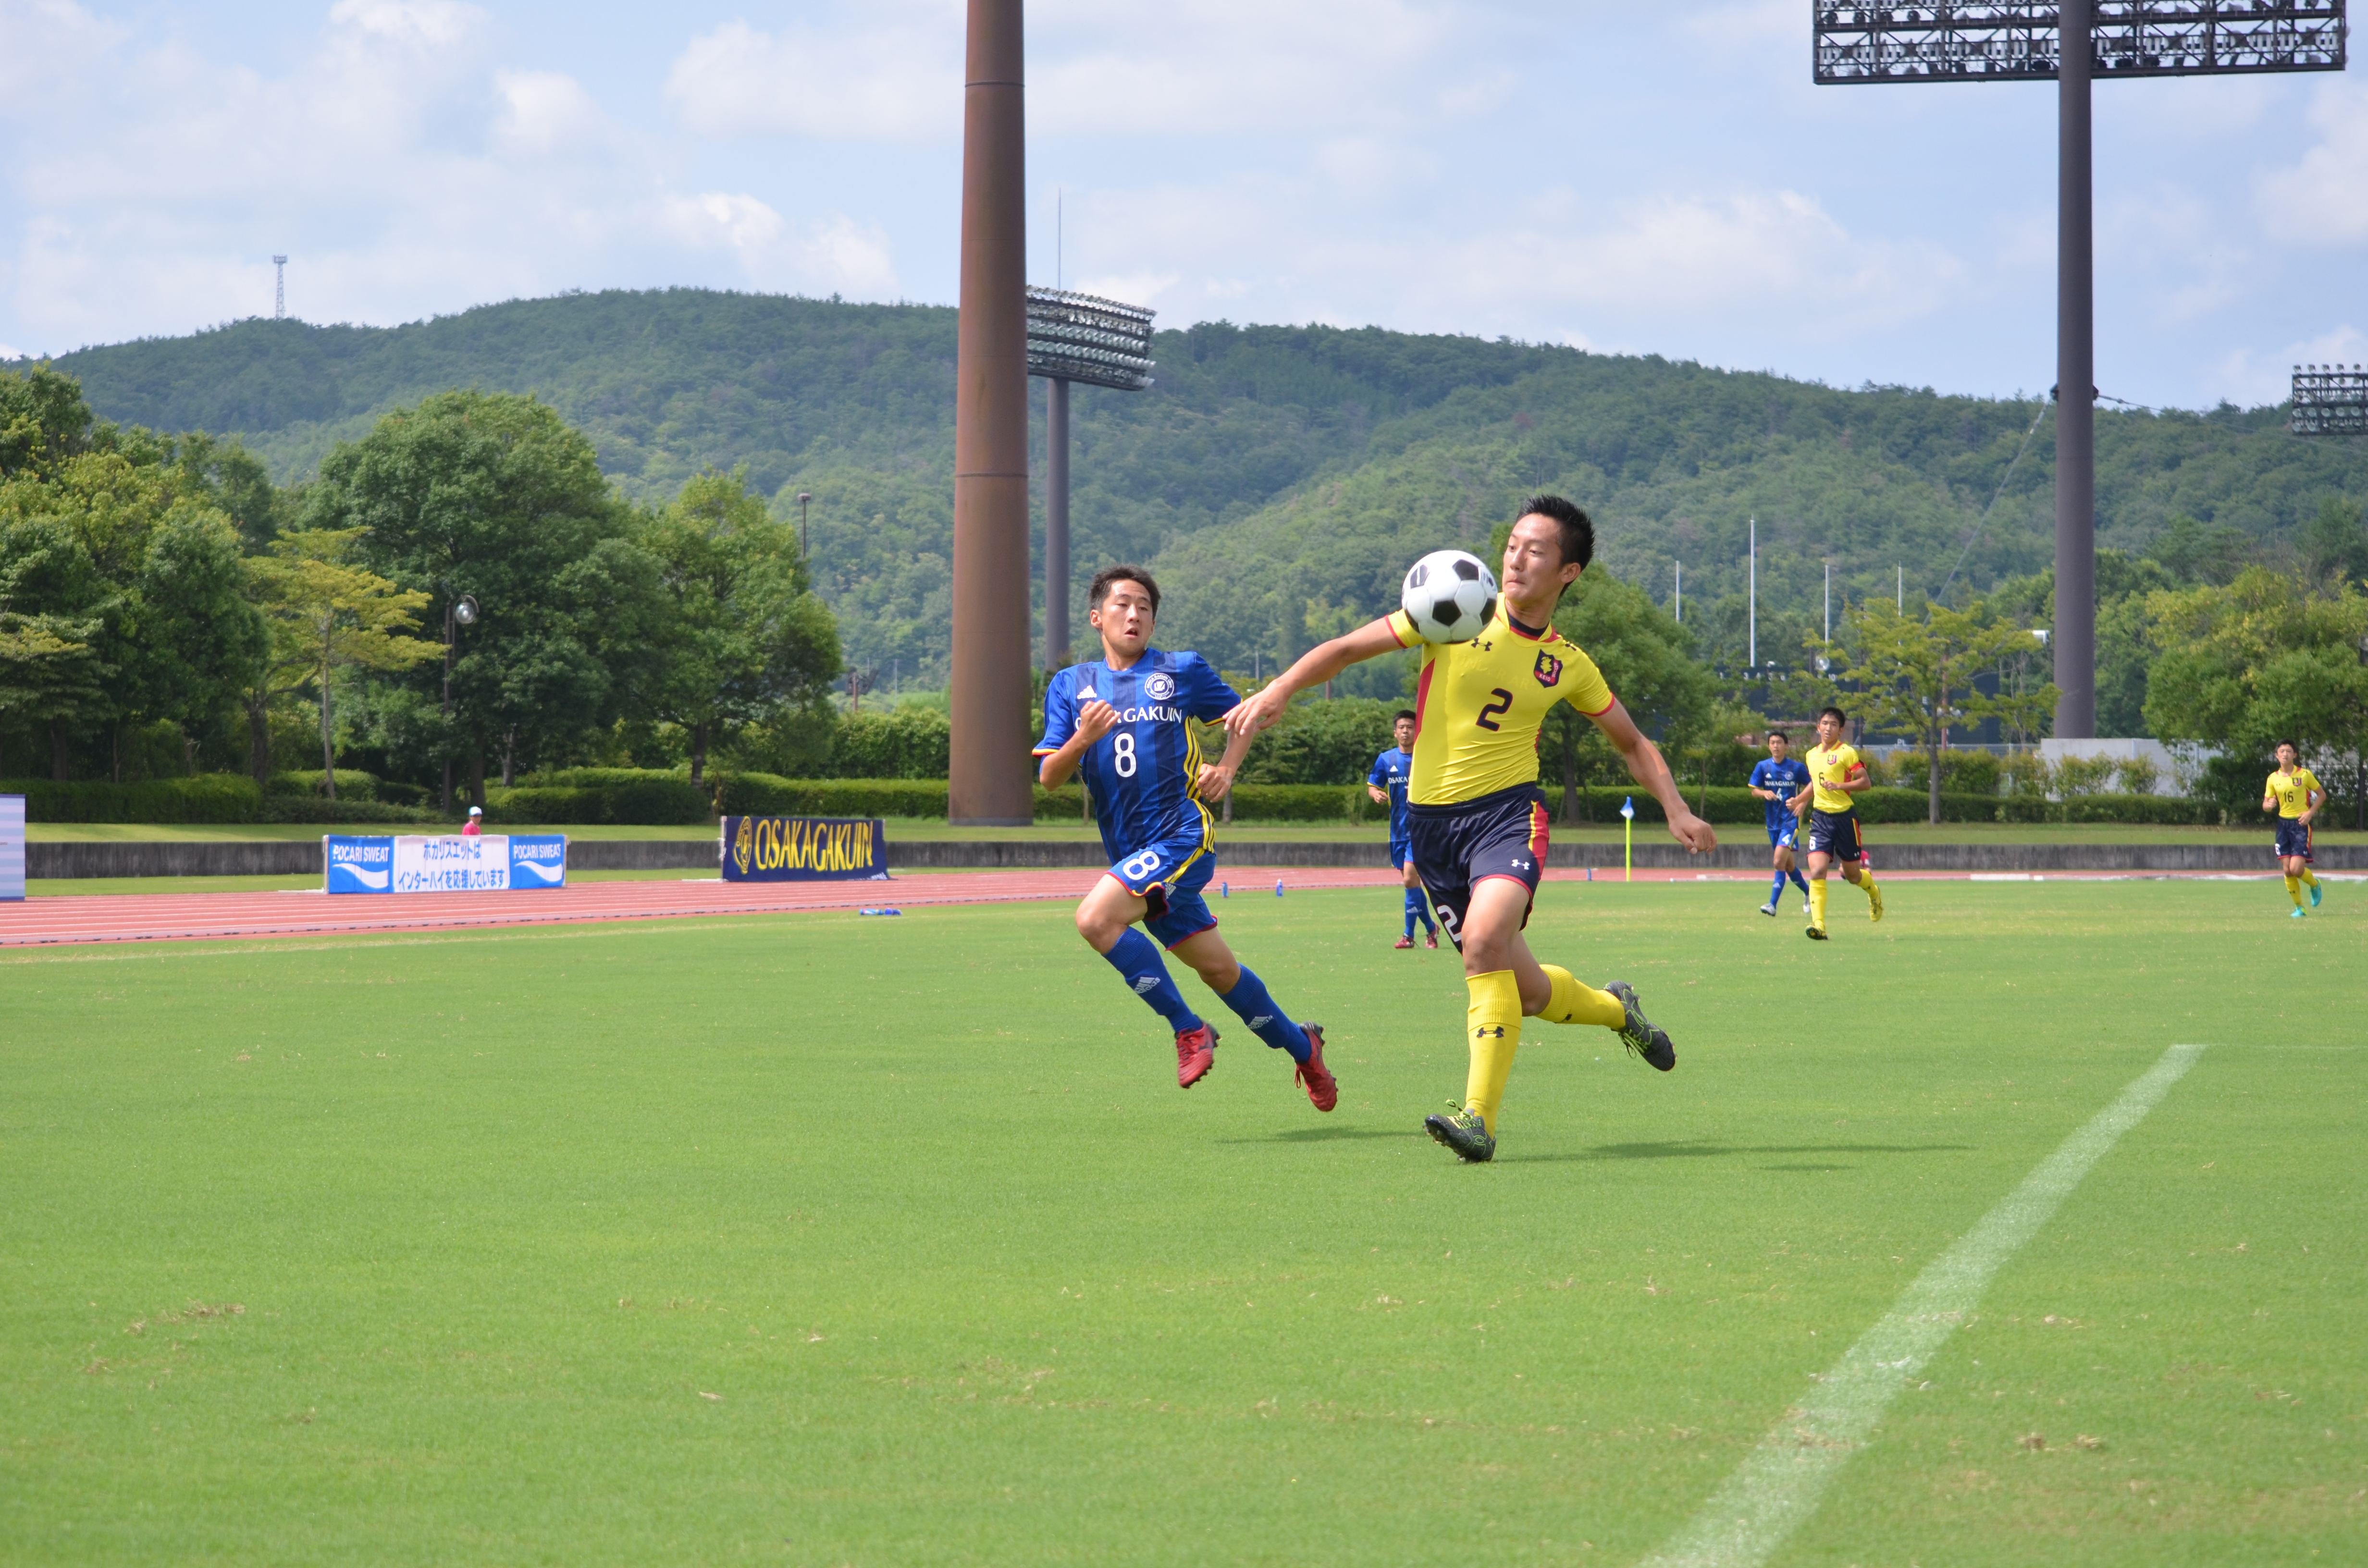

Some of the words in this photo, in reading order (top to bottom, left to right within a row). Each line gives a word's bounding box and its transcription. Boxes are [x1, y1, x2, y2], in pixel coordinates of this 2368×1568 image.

[1539, 674, 1551, 682] KEIO
[1476, 688, 1513, 732] 2
[1114, 733, 1137, 777] 8
[2284, 792, 2294, 803] 16
[755, 819, 873, 871] OSAKAGAKUIN
[1782, 833, 1791, 845] 4
[1809, 836, 1816, 851] 6
[333, 845, 362, 862] POCARI
[364, 846, 390, 862] SWEAT
[423, 841, 481, 860] ポカリスエットは
[514, 845, 538, 859] POCARI
[539, 844, 561, 858] SWEAT
[1122, 851, 1159, 880] 8
[398, 869, 505, 891] インターハイを応援しています
[1437, 905, 1461, 942] 2
